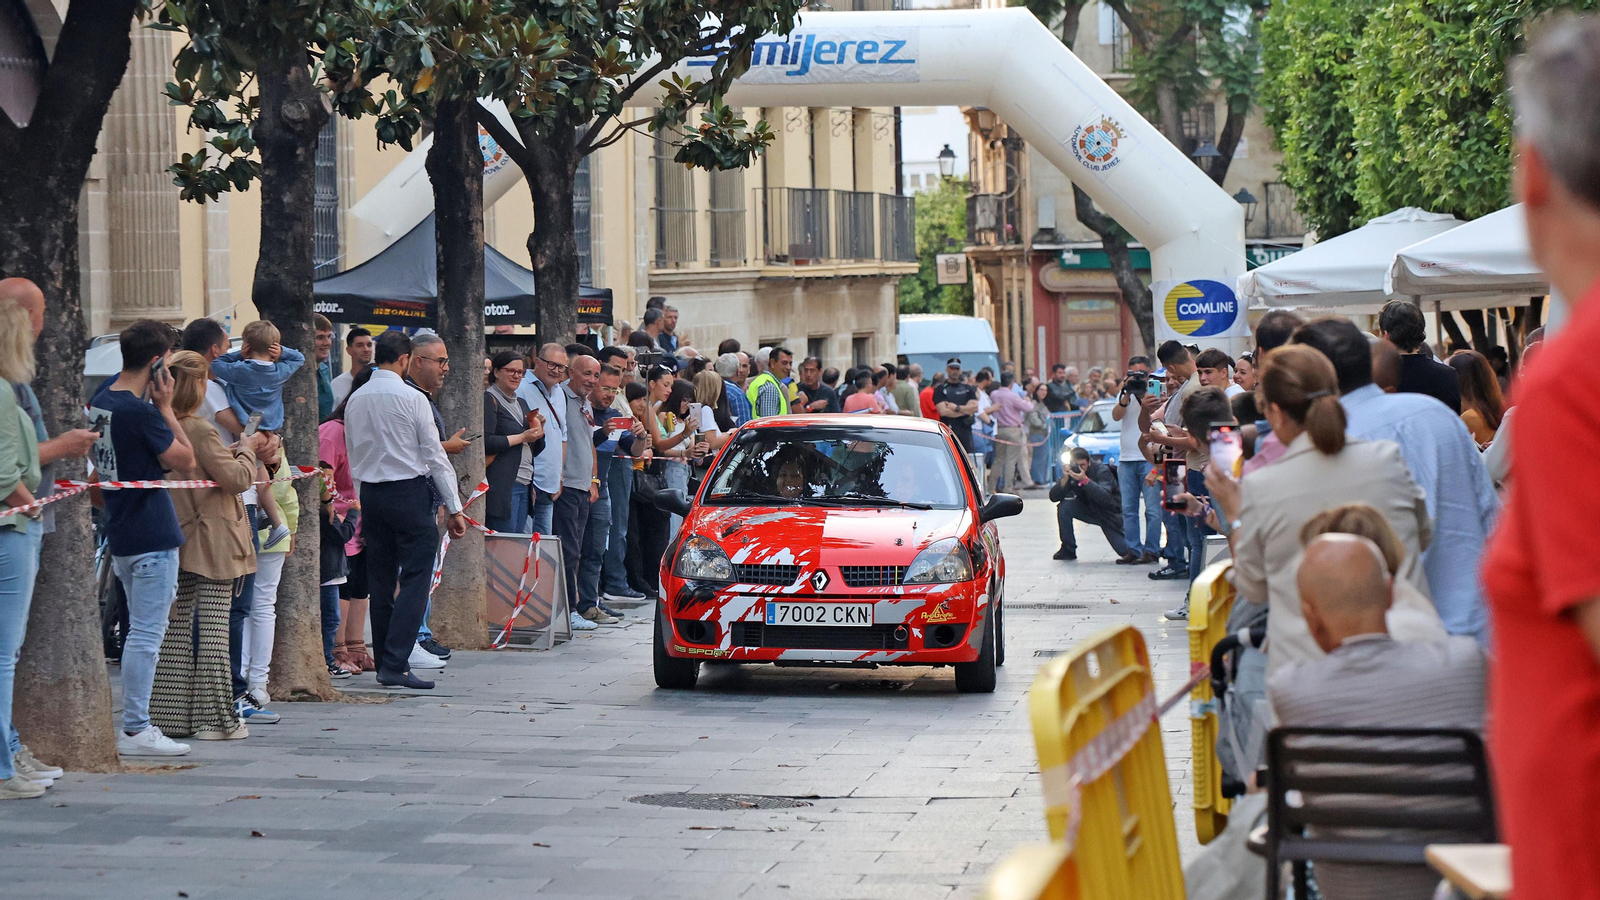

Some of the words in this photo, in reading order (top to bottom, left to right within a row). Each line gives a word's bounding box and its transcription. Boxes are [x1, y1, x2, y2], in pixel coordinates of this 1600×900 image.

[1082, 160, 1100, 171] CLUB
[1101, 157, 1120, 171] JEREZ
[1179, 301, 1234, 315] COMLINE
[779, 605, 827, 623] 7002
[832, 606, 869, 624] CKN
[674, 644, 687, 653] RS
[688, 647, 731, 657] SPORT
